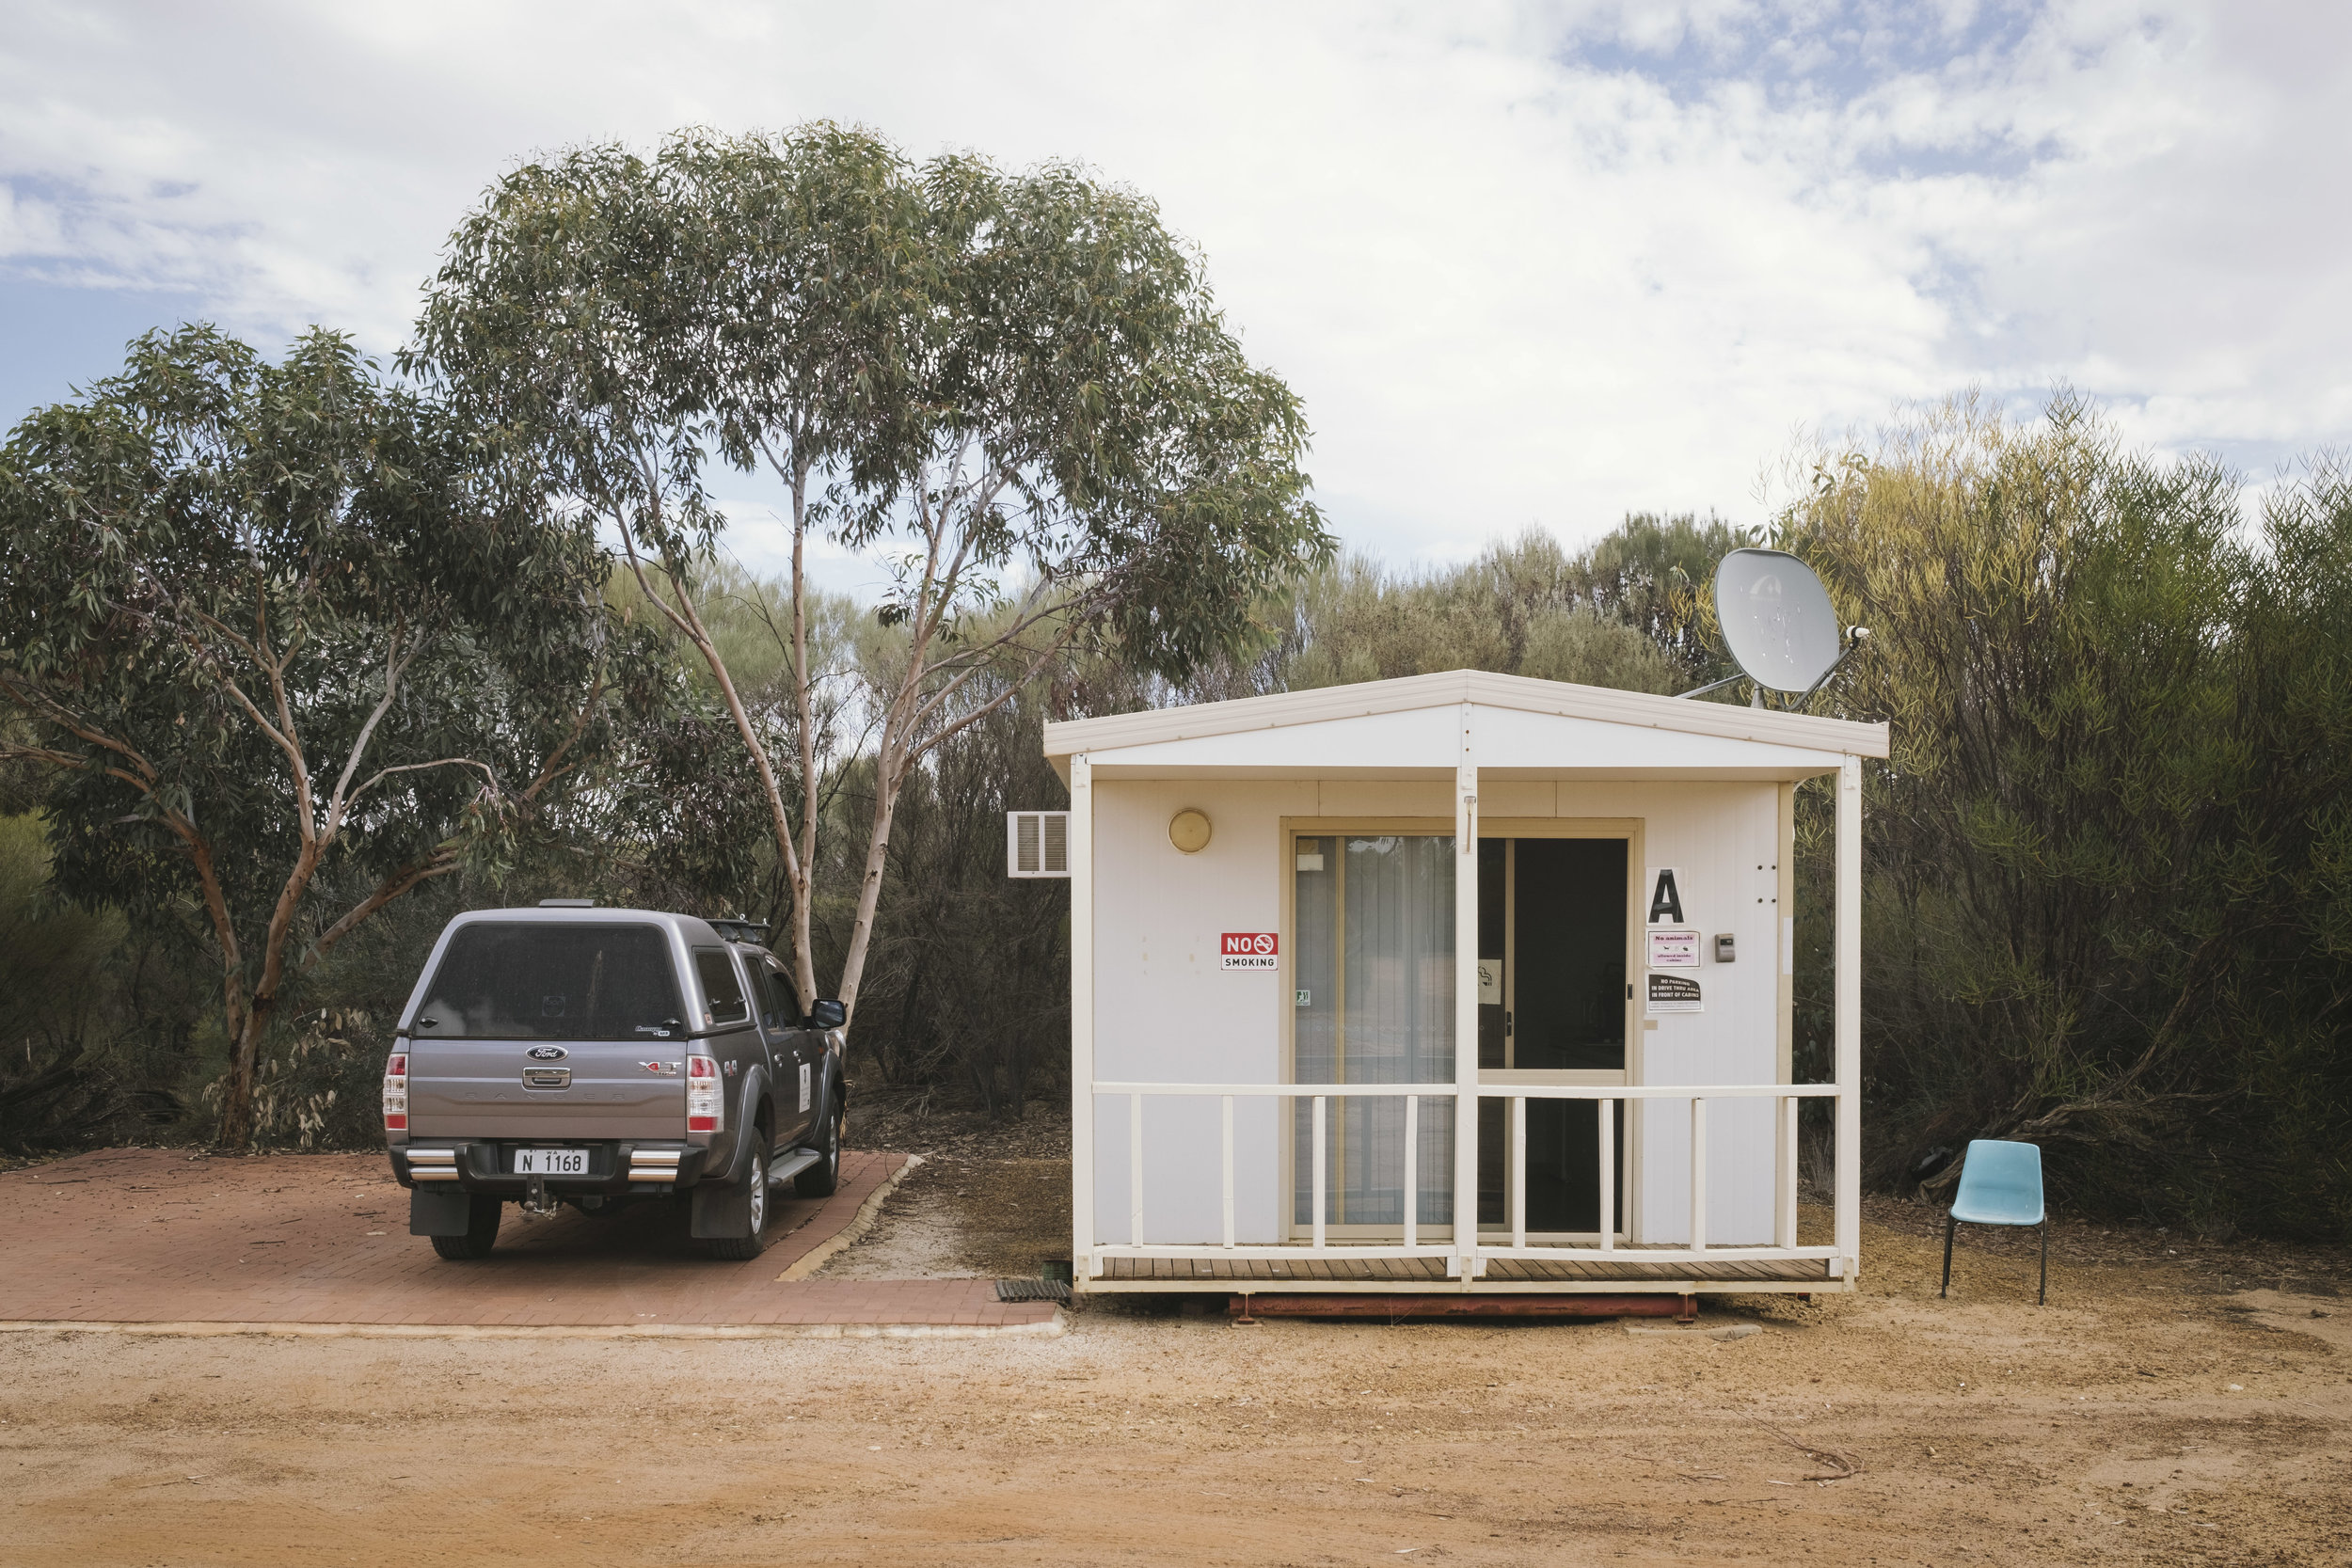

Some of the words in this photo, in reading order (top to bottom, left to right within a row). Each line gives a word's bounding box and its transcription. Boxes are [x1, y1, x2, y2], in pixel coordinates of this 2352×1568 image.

[1648, 868, 1685, 924] A
[1227, 937, 1252, 952] NO
[1225, 958, 1274, 966] SMOKING
[535, 1048, 558, 1057] Ford
[465, 1091, 626, 1101] RANGER
[523, 1155, 532, 1172] N
[546, 1155, 581, 1172] 1168
